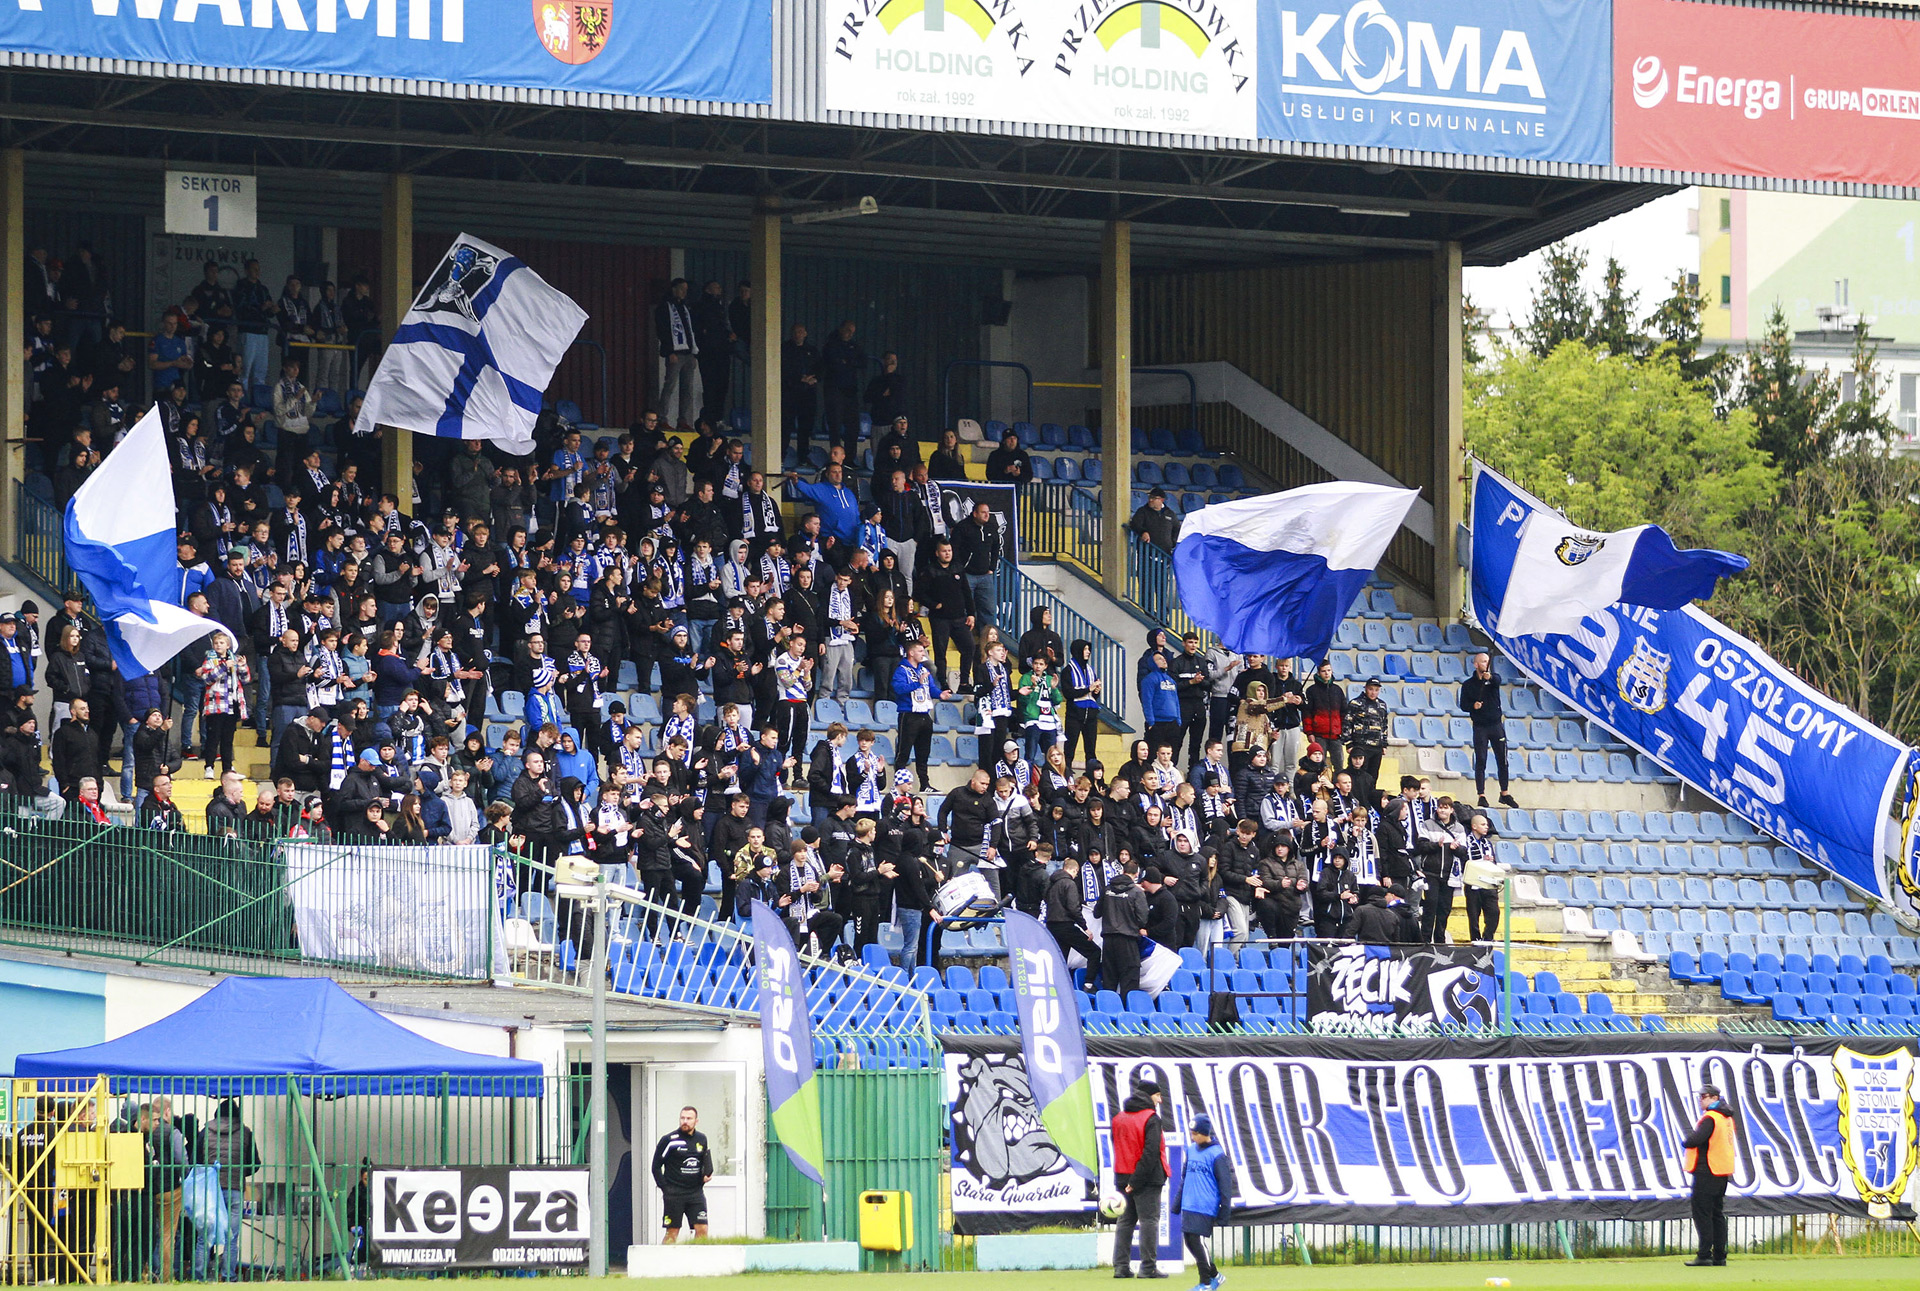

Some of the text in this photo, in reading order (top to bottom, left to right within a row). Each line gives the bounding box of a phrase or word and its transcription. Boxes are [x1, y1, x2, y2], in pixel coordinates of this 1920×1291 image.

[875, 48, 993, 78] HOLDING
[1281, 1, 1546, 99] KOMA
[1093, 64, 1209, 94] HOLDING
[1676, 65, 1781, 120] Energa
[897, 89, 917, 103] rok
[945, 91, 975, 106] 1992
[1803, 87, 1920, 115] GRUPA ORLEN
[1114, 105, 1133, 118] rok
[1161, 108, 1190, 122] 1992
[1282, 101, 1546, 138] USŁUGI KOMUNALNE
[181, 176, 241, 193] SEKTOR
[202, 194, 220, 232] 1
[1693, 637, 1859, 758] OSZOŁOMY
[1863, 1071, 1888, 1085] OKS
[1858, 1093, 1899, 1107] STOMIL
[1346, 1064, 1467, 1197] TO
[384, 1176, 579, 1234] keeza
[953, 1179, 1073, 1206] Stara Gwardia
[382, 1248, 457, 1263] WWW.KEEZA.PL
[526, 1247, 584, 1262] SPORTOWA
